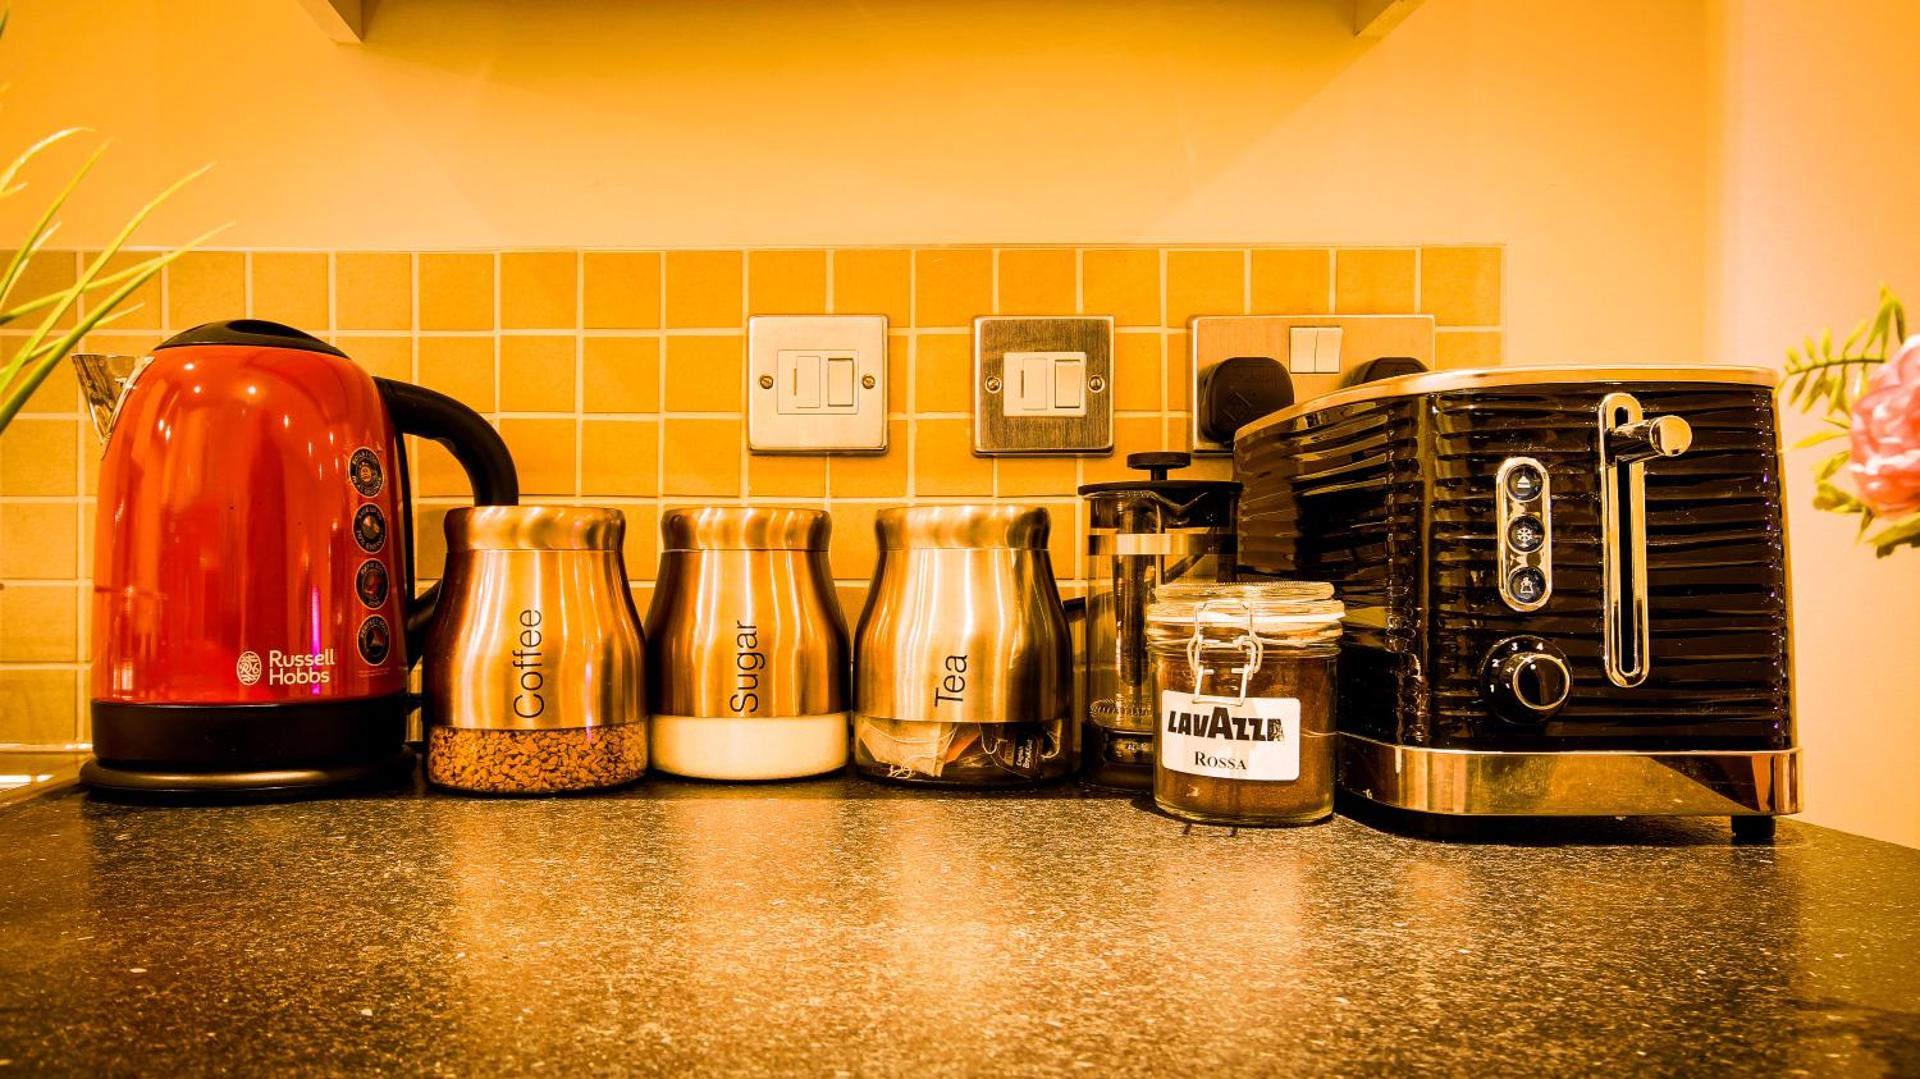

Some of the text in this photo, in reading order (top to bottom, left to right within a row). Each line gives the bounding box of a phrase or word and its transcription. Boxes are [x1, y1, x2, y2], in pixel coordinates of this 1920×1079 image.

[1511, 642, 1518, 651] 3
[1536, 642, 1544, 651] 4
[269, 648, 335, 668] Russell
[512, 609, 545, 719] Coffee
[729, 619, 766, 713] Sugar
[1491, 658, 1500, 668] 2
[269, 666, 330, 686] Hobbs
[934, 654, 968, 708] Tea
[1489, 683, 1495, 693] 1
[1167, 706, 1284, 742] LAVAZZA
